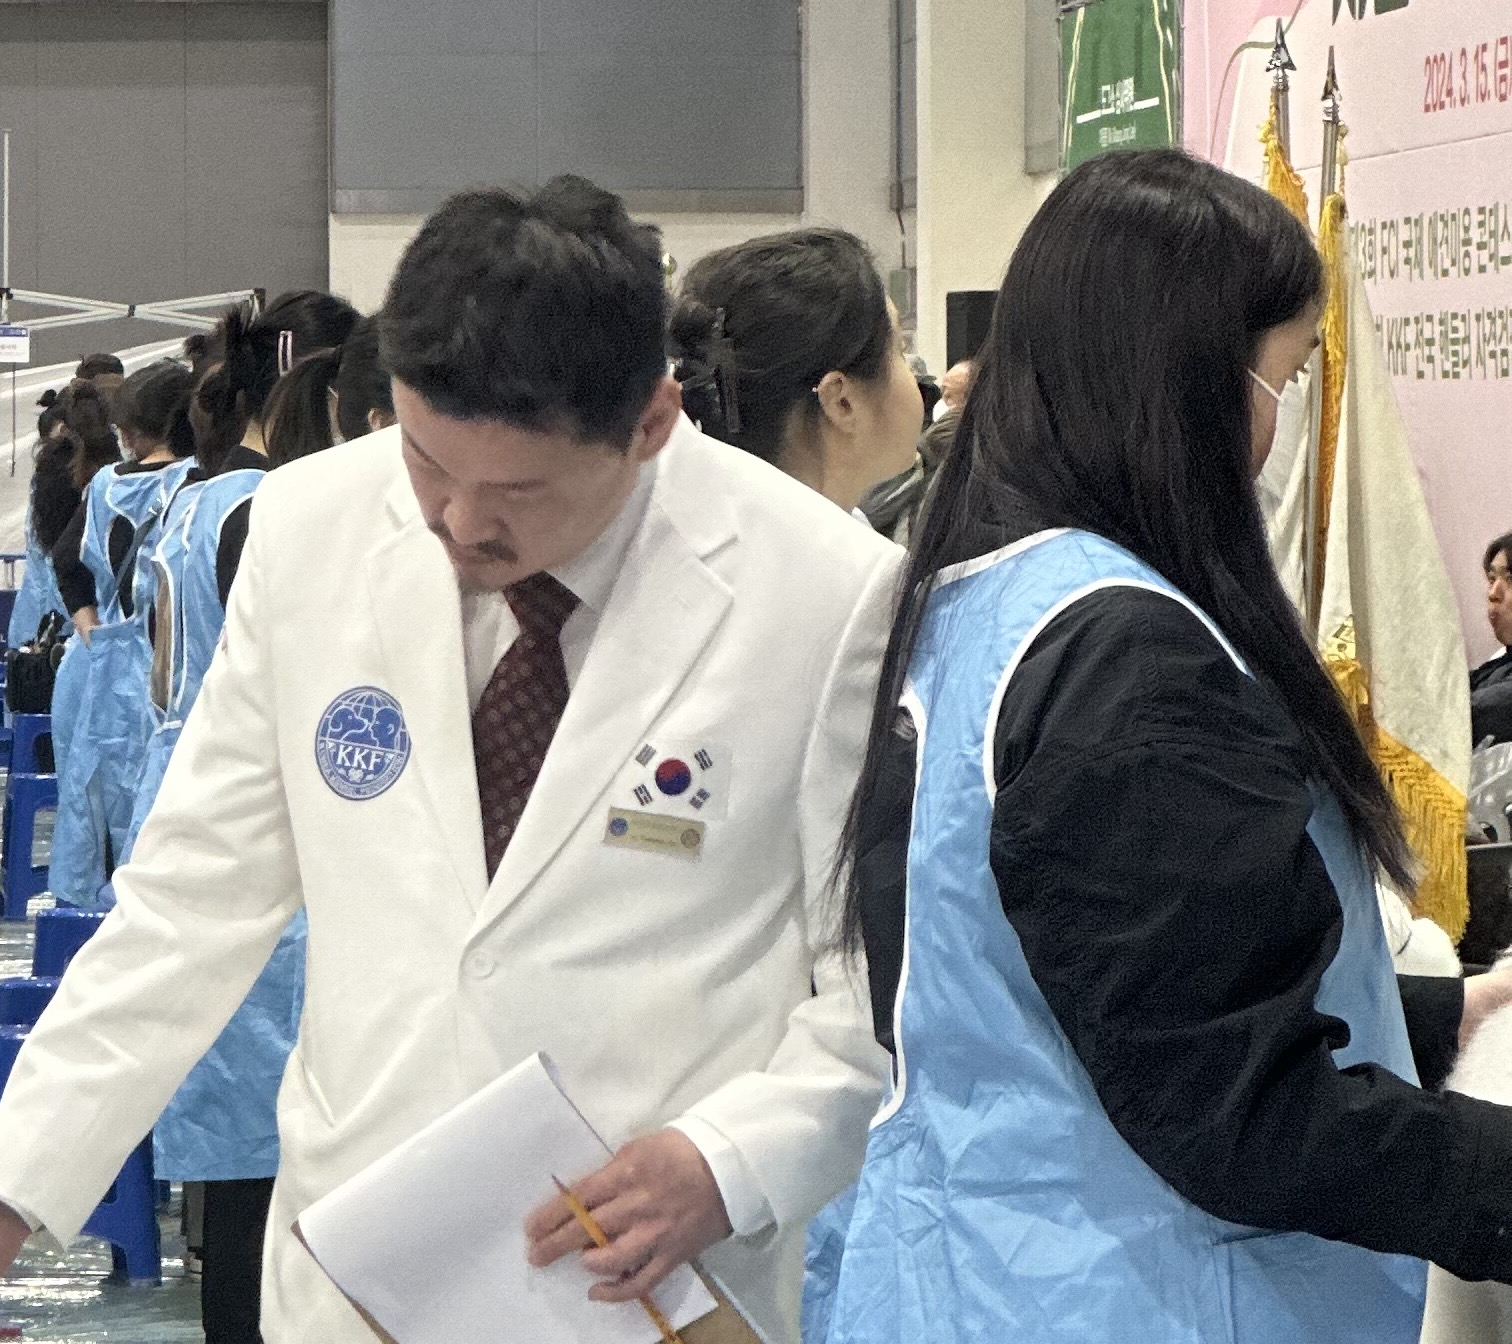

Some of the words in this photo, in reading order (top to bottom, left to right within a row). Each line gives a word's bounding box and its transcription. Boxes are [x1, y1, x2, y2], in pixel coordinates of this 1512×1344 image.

[1381, 218, 1399, 280] FCI
[1403, 212, 1425, 283] 국제
[1428, 206, 1473, 281] 애견미용
[1387, 316, 1411, 377] KKF
[1414, 311, 1436, 381] 전국
[1438, 308, 1472, 380] 핸들러
[1474, 305, 1512, 380] 자격검
[336, 744, 384, 771] KKF
